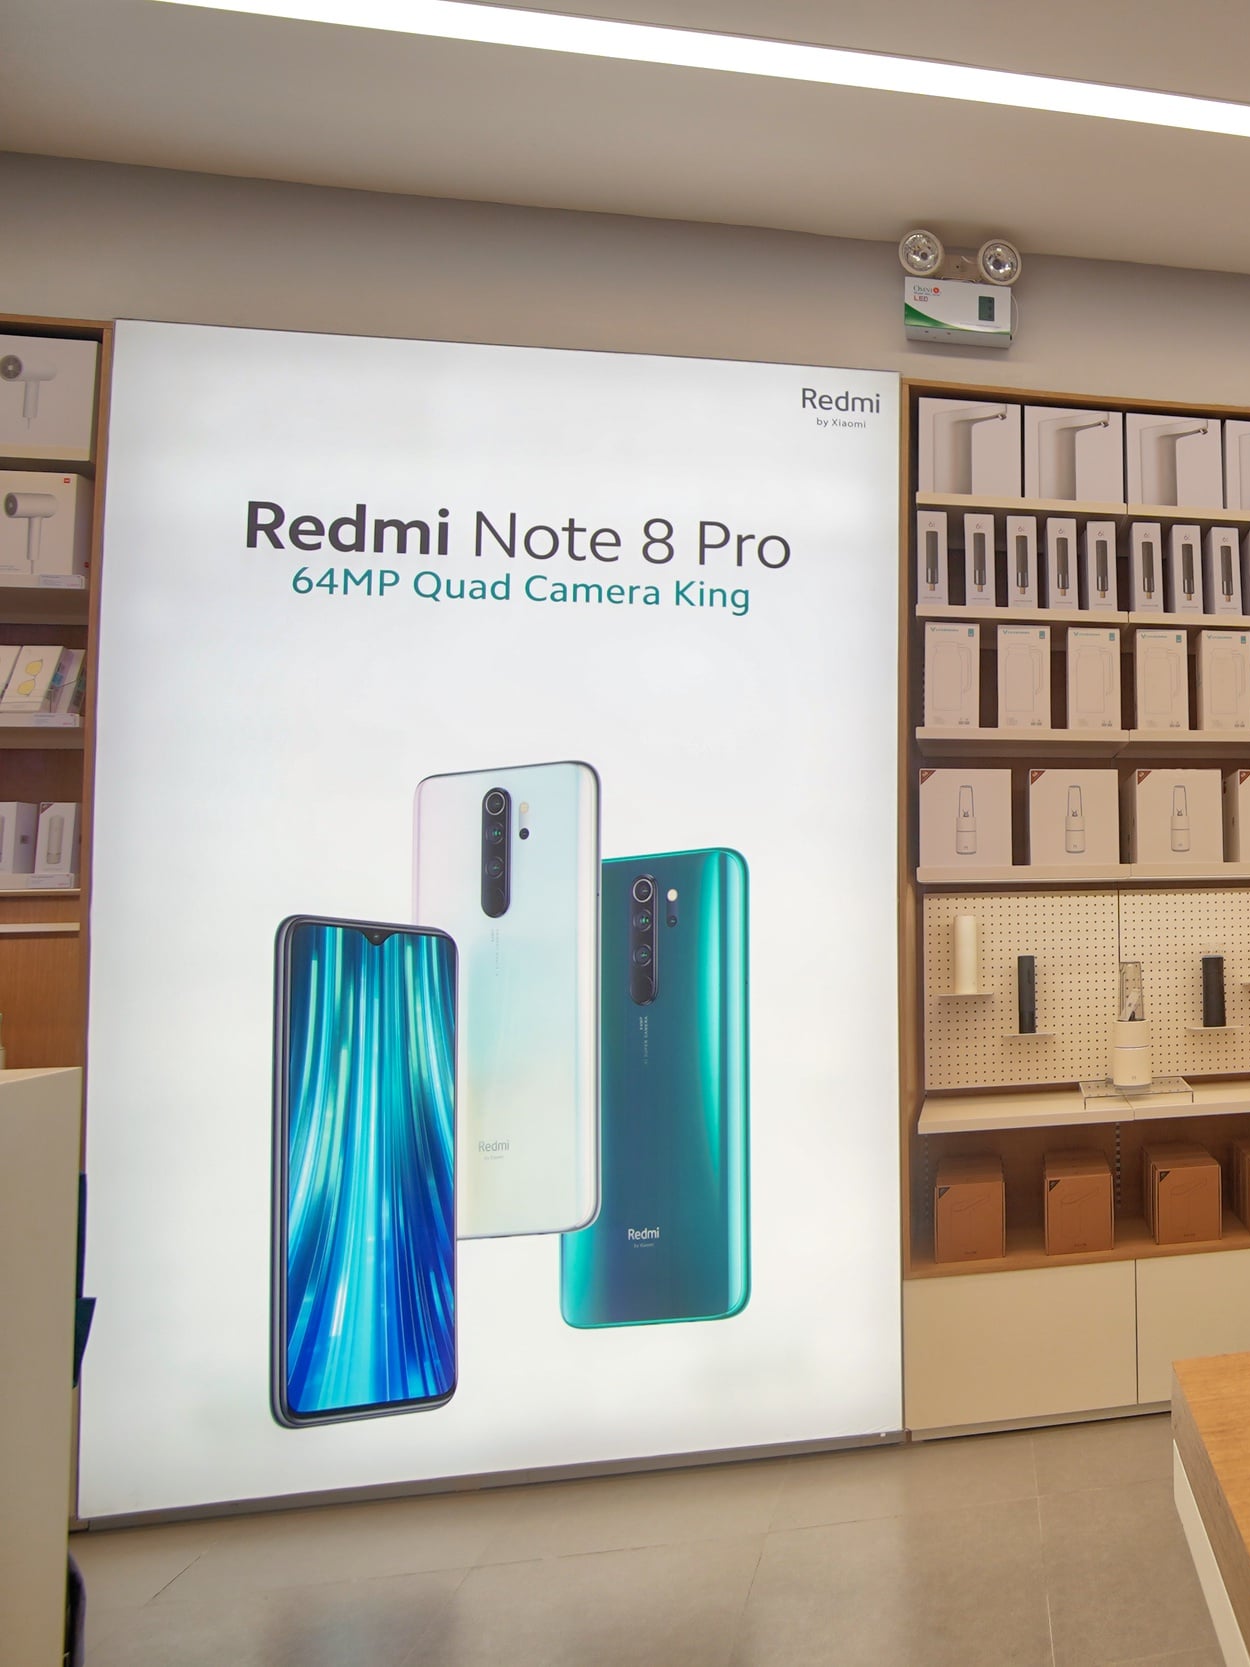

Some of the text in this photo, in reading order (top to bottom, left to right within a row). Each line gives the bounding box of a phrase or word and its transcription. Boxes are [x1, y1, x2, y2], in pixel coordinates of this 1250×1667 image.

[802, 388, 880, 413] Redmi
[816, 417, 866, 428] by Xiaomi
[245, 500, 792, 569] Redmi Note 8 Pro
[291, 566, 751, 616] 64MP Quad Camera King
[478, 1139, 510, 1152] Redmi
[627, 1227, 660, 1240] Redmi
